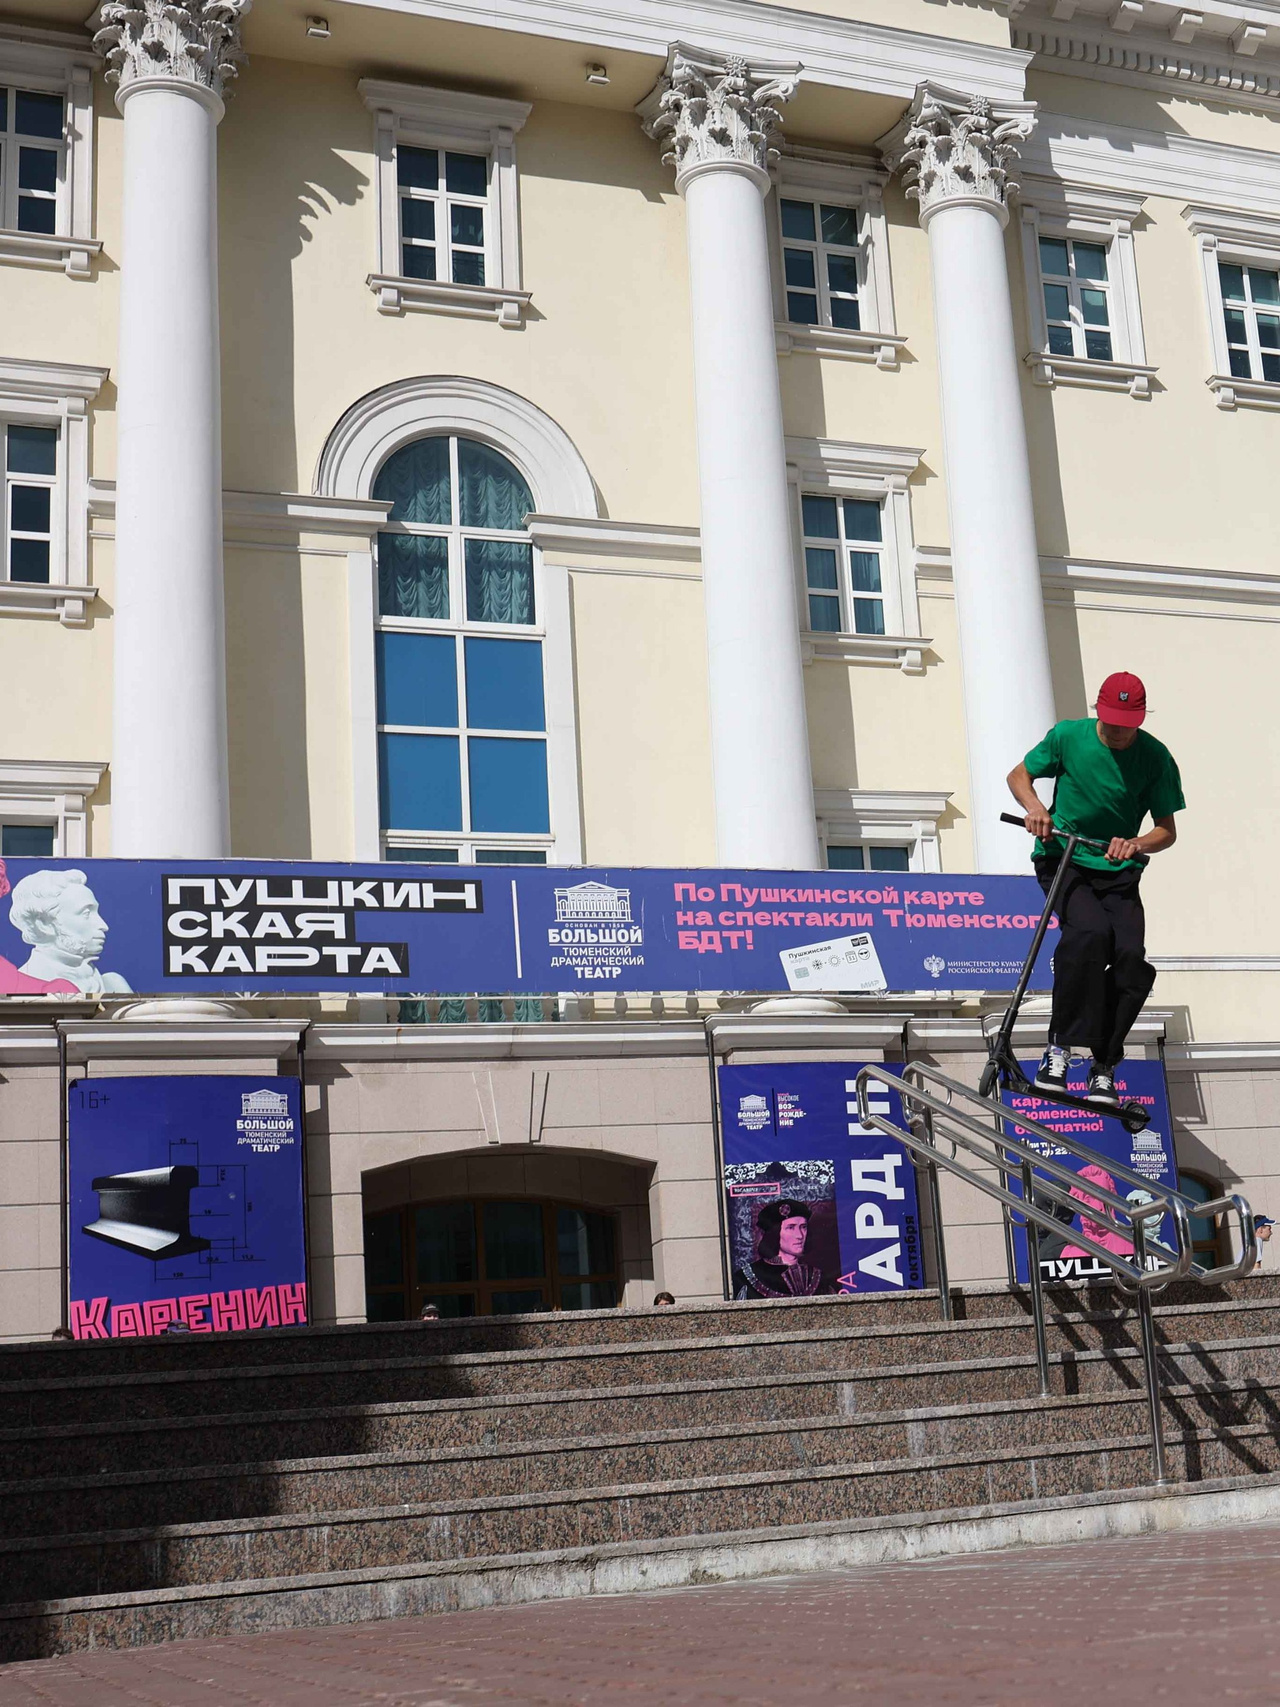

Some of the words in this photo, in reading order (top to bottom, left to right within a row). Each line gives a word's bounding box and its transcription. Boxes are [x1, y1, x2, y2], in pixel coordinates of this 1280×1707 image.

[168, 878, 478, 909] ПУШКИН
[673, 883, 716, 902] По
[720, 883, 899, 908] Пушкинской
[903, 890, 985, 910] карте
[167, 911, 347, 940] СКАЯ
[676, 911, 714, 926] на
[718, 911, 874, 927] спектакли
[882, 909, 1060, 929] Тюменского
[548, 926, 643, 943] БОЛЬШОЙ
[677, 930, 754, 953] БДТ!
[562, 945, 632, 956] ТЮМЕНСКИЙ
[788, 945, 832, 959] Пушкинская
[168, 945, 402, 974] КАРТА
[551, 955, 645, 967] ДРАМАТИЧЕСКИЙ
[574, 967, 622, 979] ТЕАТР
[79, 1090, 111, 1110] 16+
[738, 1110, 771, 1118] БОЛЬШОЙ
[236, 1118, 294, 1130] БОЛЬШОЙ
[237, 1137, 295, 1145] ДРАМАТИЧЕСКИЙ
[251, 1144, 281, 1152] ТЕАТР
[1130, 1152, 1168, 1162] БОЛЬШОЙ
[70, 1282, 307, 1340] КАРЕНИН
